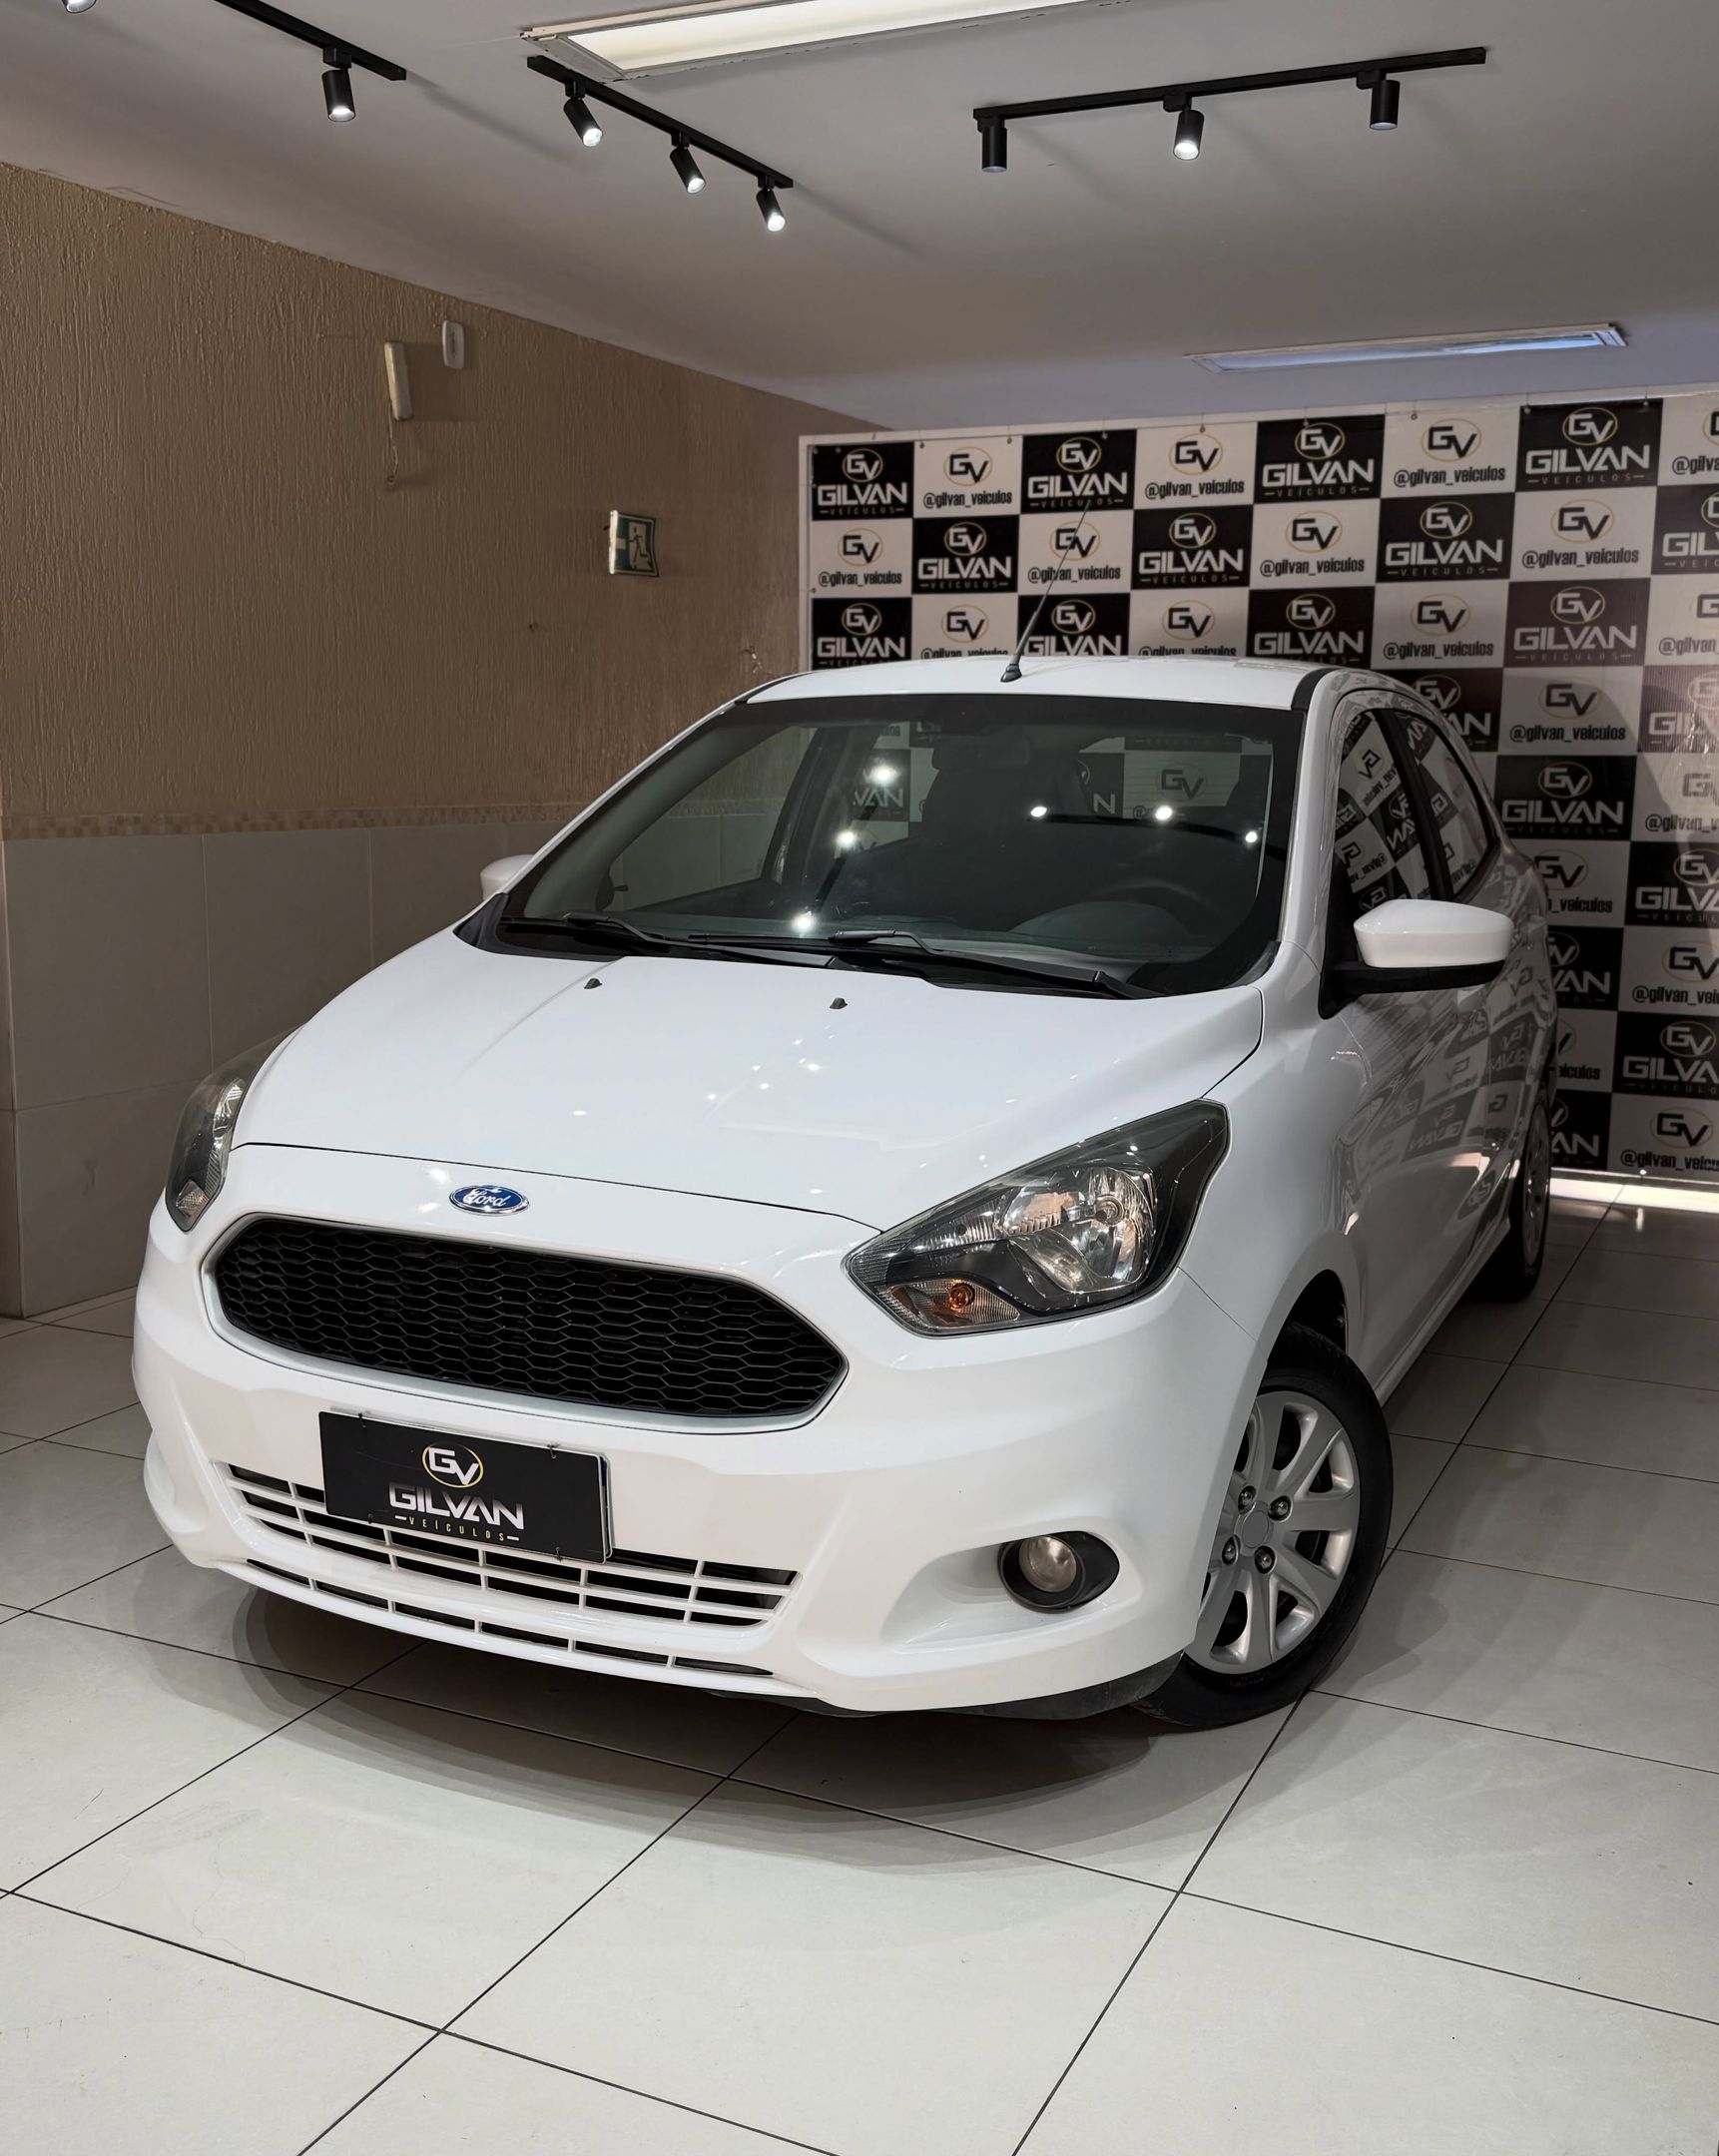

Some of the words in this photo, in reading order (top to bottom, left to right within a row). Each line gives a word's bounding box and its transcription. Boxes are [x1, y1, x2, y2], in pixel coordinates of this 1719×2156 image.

[1568, 413, 1613, 442] GV
[1300, 428, 1341, 457] GV
[1428, 426, 1477, 458] GV
[848, 454, 879, 480] GV
[949, 453, 988, 483] GV
[1062, 443, 1097, 470] GV
[1175, 440, 1219, 472] GV
[1525, 444, 1650, 474] GILVAN
[1027, 472, 1127, 498] GILVAN
[1262, 459, 1374, 487] GILVAN
[1394, 465, 1505, 488] @gilvan_veiculos
[818, 482, 907, 506] GILVAN
[923, 489, 1012, 509] @gilvan_veiculos
[1145, 479, 1244, 500] @gilvan_veiculos
[1174, 519, 1212, 547] GV
[1292, 518, 1338, 549] GV
[1426, 507, 1467, 536] GV
[1558, 506, 1610, 540] GV
[843, 535, 879, 564] GV
[948, 528, 982, 554] GV
[1055, 527, 1096, 558] GV
[1385, 539, 1503, 566] GILVAN
[917, 556, 1011, 580] GILVAN
[1138, 549, 1244, 575] GILVAN
[1260, 558, 1365, 578] @gilvan_veiculos
[1522, 548, 1639, 569] @gilvan_veiculos
[819, 570, 902, 587] @gilvan_veiculos
[1028, 565, 1121, 584] @gilvan_veiculos
[1056, 605, 1092, 632] GV
[1292, 599, 1332, 628] GV
[1418, 601, 1466, 633] GV
[1556, 593, 1602, 621] GV
[847, 608, 878, 634] GV
[947, 611, 985, 640] GV
[1169, 607, 1211, 637] GV
[817, 637, 905, 659] GILVAN
[1024, 635, 1121, 656] GILVAN
[1254, 630, 1364, 655] GILVAN
[1383, 640, 1493, 660] @gilvan_veiculos
[1513, 625, 1637, 651] GILVAN
[1547, 684, 1597, 716] GV
[1509, 725, 1626, 744] @gilvan_veiculos
[1543, 767, 1589, 797] GV
[1501, 800, 1624, 824] GILVAN
[1666, 1025, 1713, 1056] GV
[1656, 1112, 1710, 1147] GV
[462, 1188, 512, 1207] Ford
[428, 1446, 480, 1485] GV
[388, 1482, 525, 1530] GILVAN
